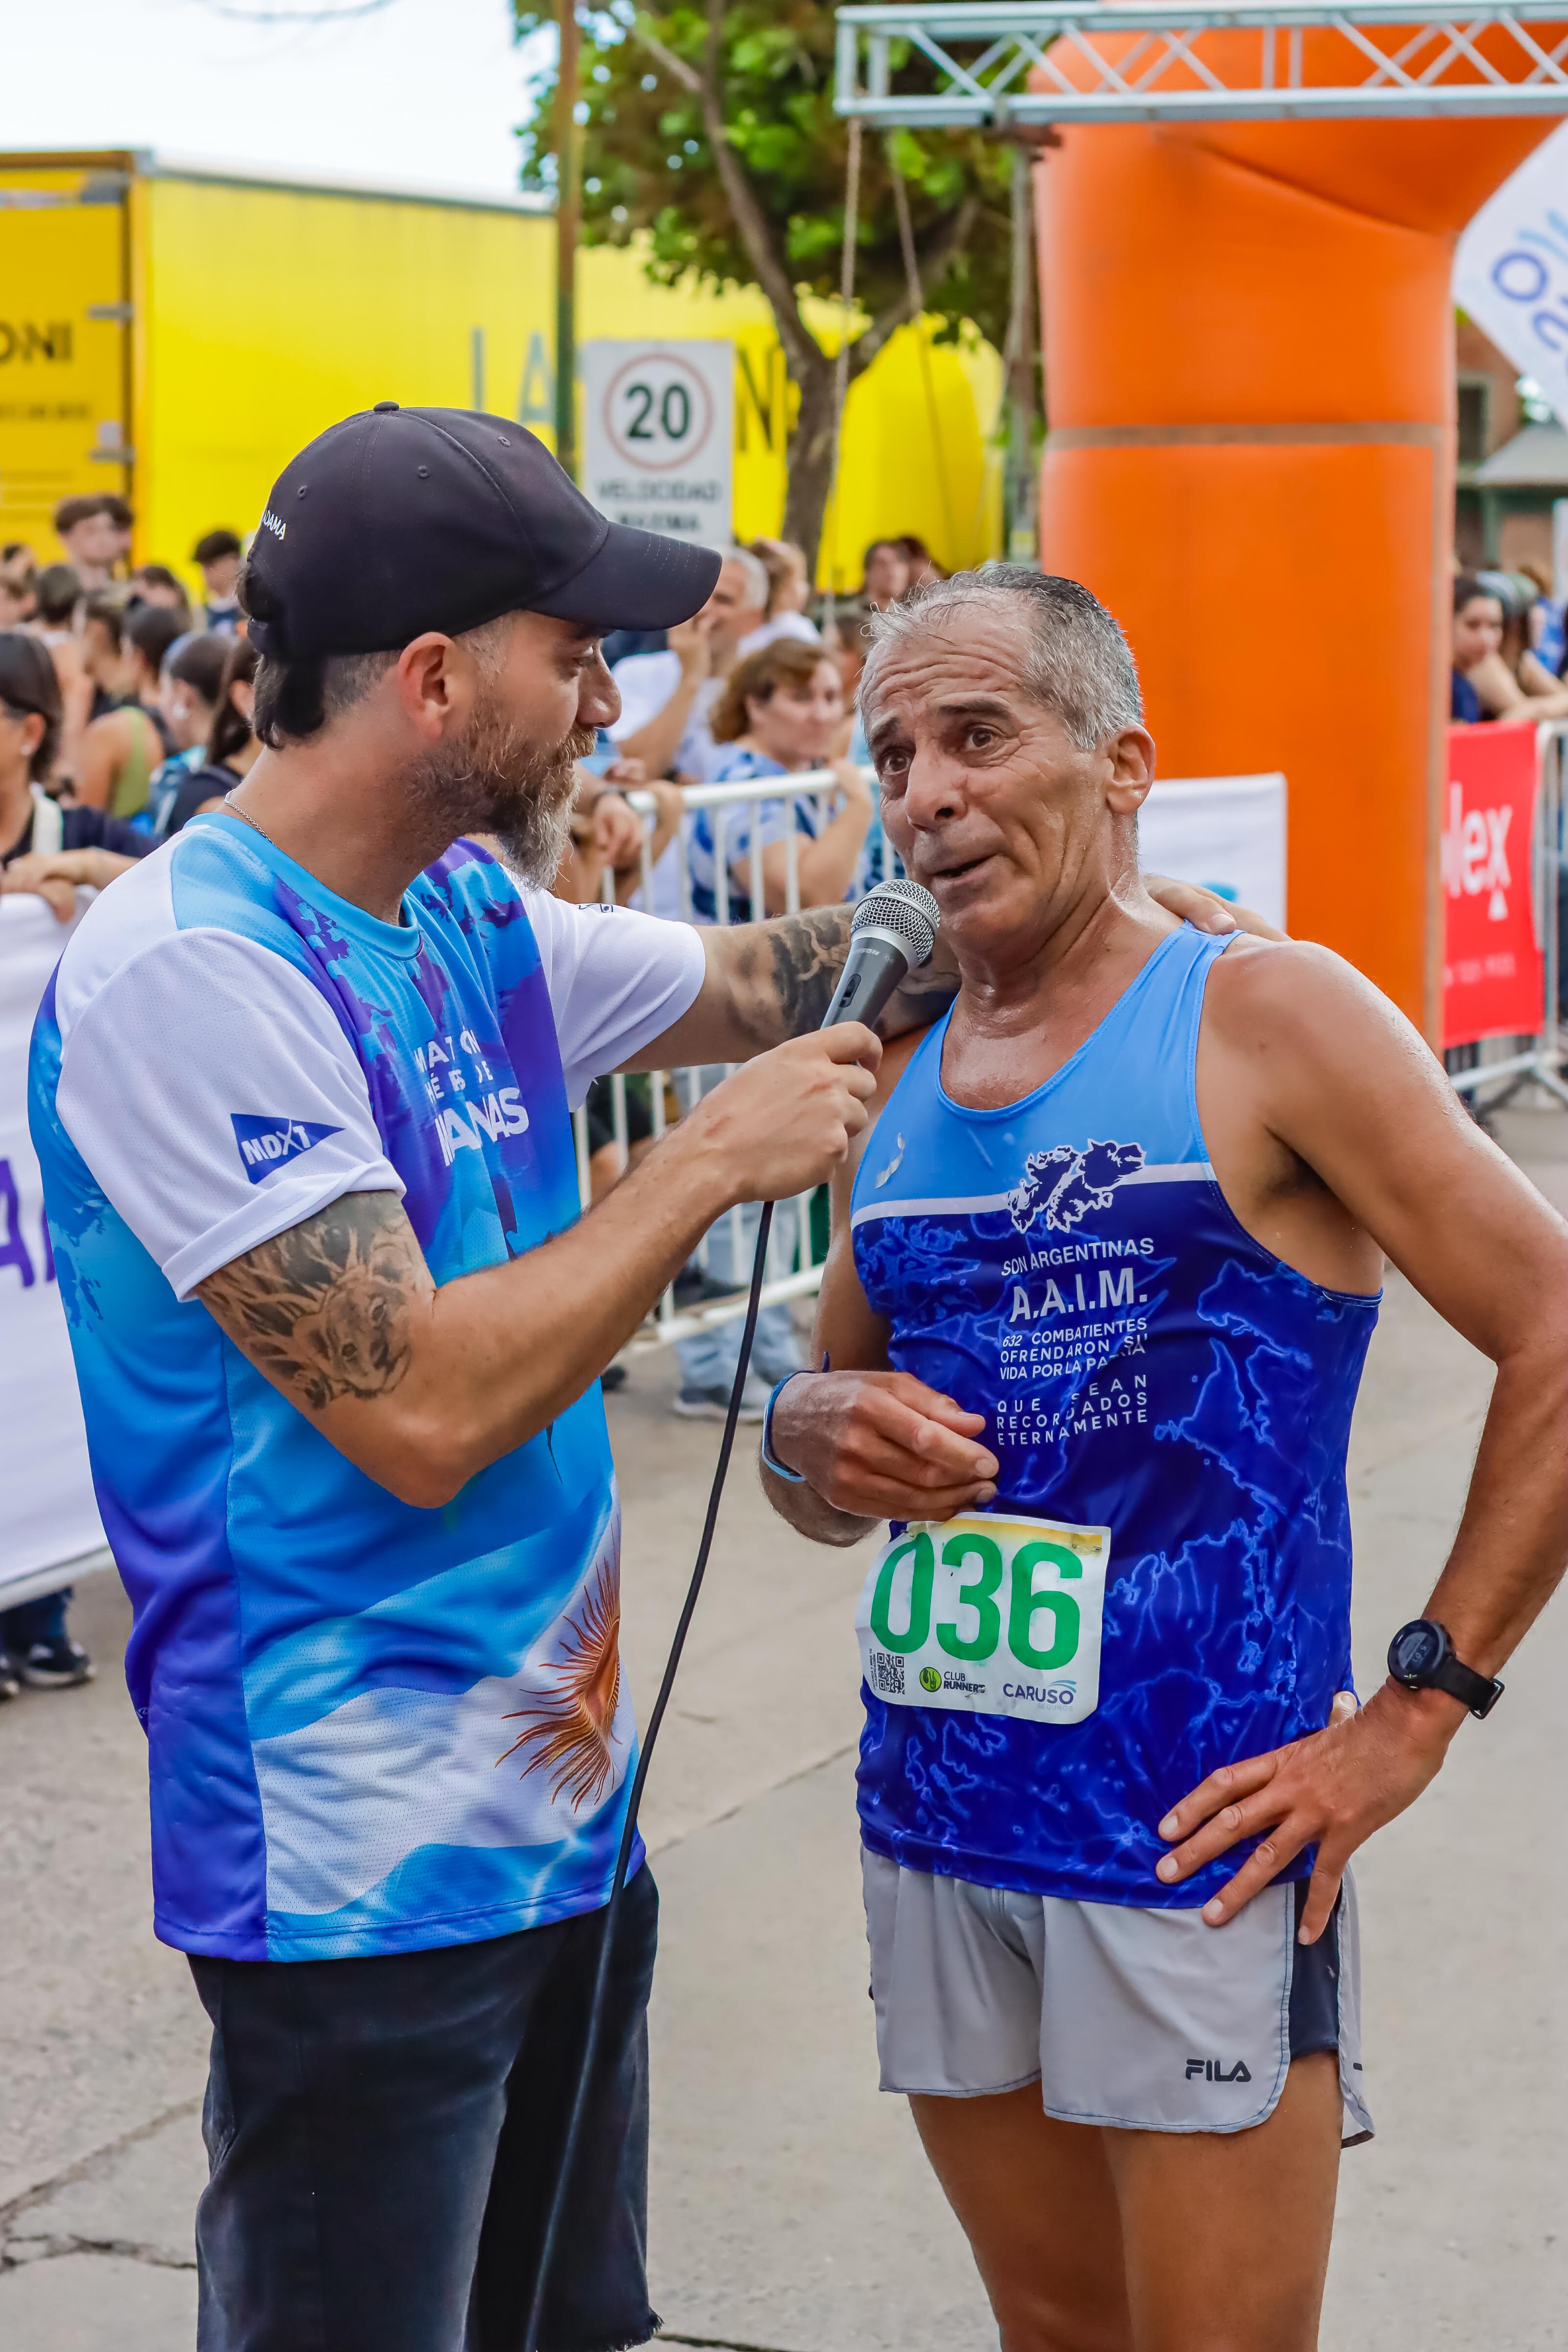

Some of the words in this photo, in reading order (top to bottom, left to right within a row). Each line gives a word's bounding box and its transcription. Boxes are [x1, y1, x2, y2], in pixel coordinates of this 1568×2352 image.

[625, 382, 691, 440] 20
[1001, 1256, 1028, 1276] SON
[1030, 1238, 1154, 1270] ARGENTINAS
[1009, 1267, 1148, 1323] A.A.I.M.
[1002, 1335, 1023, 1348] 632
[1031, 1317, 1147, 1345] COMBATIENTES
[1000, 1339, 1109, 1363] OFRENDARON
[1000, 1366, 1028, 1380] VIDA
[1032, 1363, 1063, 1378] POR
[1065, 1360, 1082, 1374] LA
[997, 1398, 1040, 1412] QUE
[997, 1392, 1147, 1429] RECORDADOS
[998, 1409, 1148, 1446] ETERNAMENTE
[870, 1532, 1083, 1670] 036
[944, 1671, 965, 1682] CLUB
[1003, 1683, 1074, 1705] CARUSO
[1037, 1703, 1074, 1712] SEGUROS
[1185, 2058, 1252, 2082] FILA
